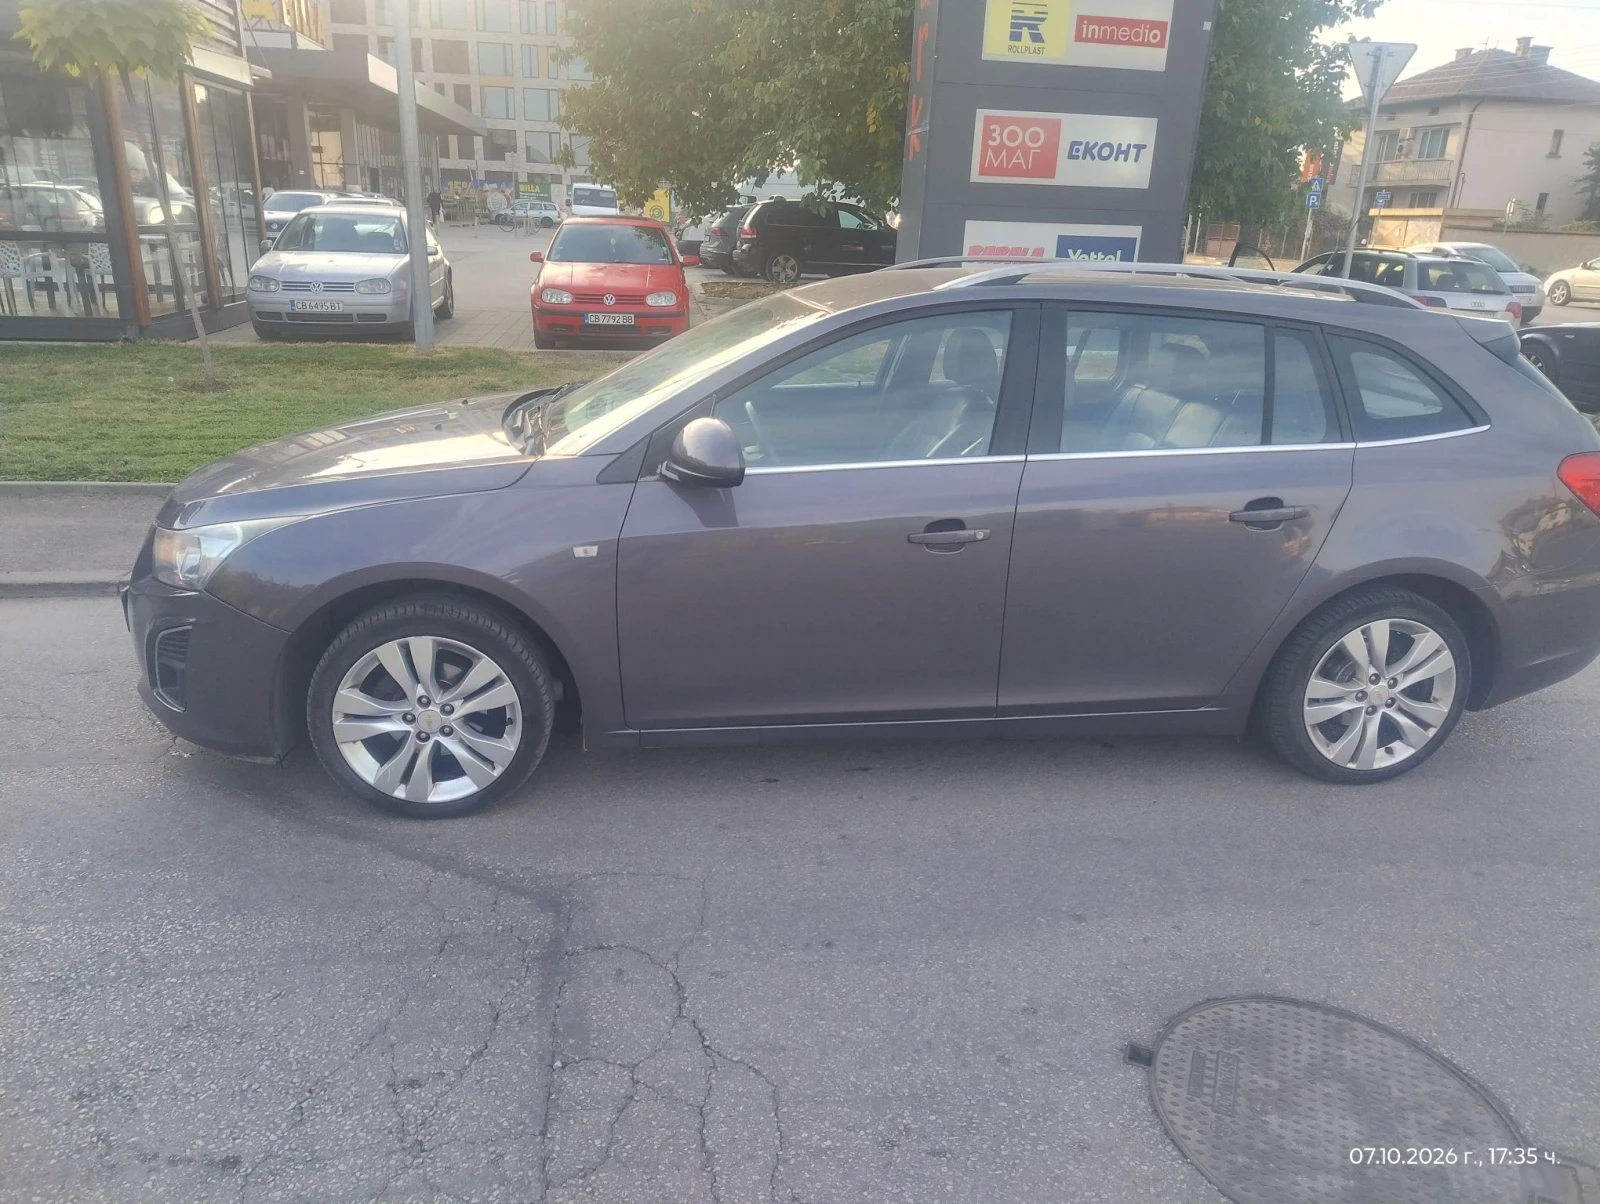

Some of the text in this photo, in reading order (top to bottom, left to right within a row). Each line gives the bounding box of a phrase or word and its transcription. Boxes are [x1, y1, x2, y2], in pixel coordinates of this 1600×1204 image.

[1081, 20, 1161, 44] inmedio
[1007, 45, 1046, 56] ROLLPLAST
[984, 148, 1041, 170] МАГ
[1067, 140, 1148, 163] ЕКОНТ
[296, 301, 341, 310] CB 6495 BT
[590, 314, 632, 324] CB 7792 BB
